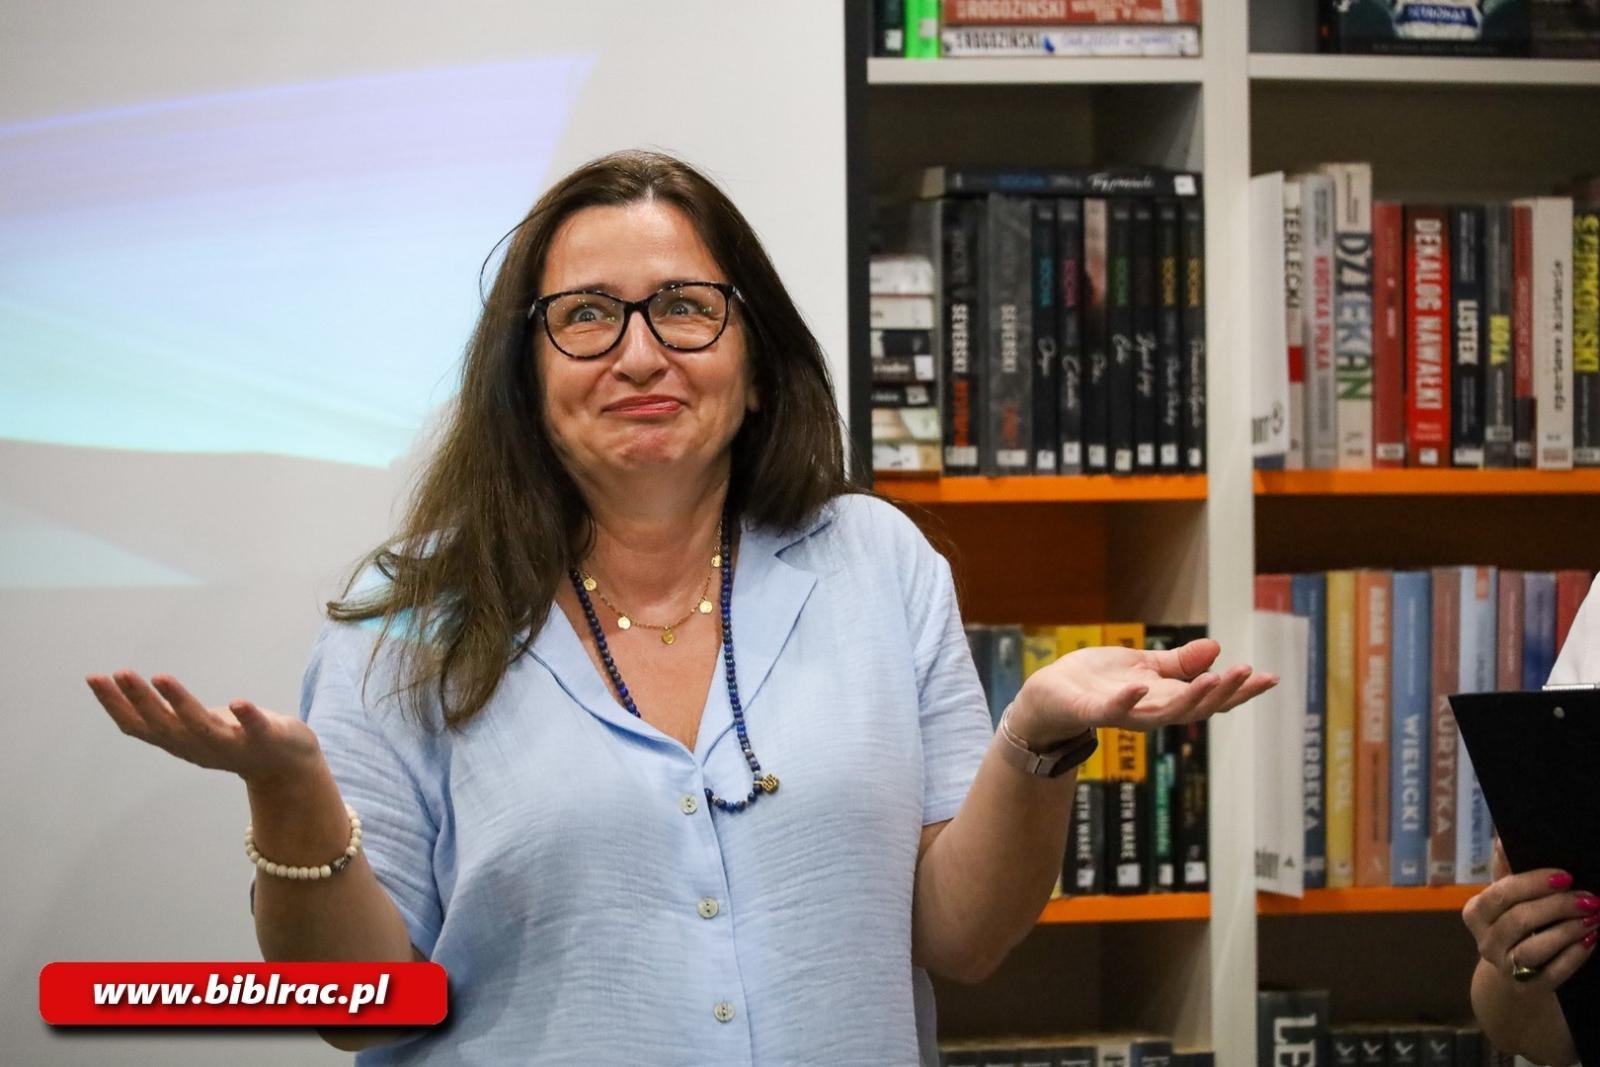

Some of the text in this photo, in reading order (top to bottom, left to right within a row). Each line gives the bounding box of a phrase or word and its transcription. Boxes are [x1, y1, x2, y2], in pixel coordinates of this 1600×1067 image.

[1284, 207, 1301, 309] TERLECKI
[1415, 218, 1443, 311] DEKALOG
[952, 304, 968, 373] SEVERSKI
[1001, 304, 1016, 373] SEVERSKI
[1335, 232, 1372, 401] DZIEKAN
[1416, 316, 1443, 410] NAWAŁKI
[1304, 713, 1322, 832] BERBEKA
[1402, 713, 1420, 832] WIELICKI
[1437, 694, 1455, 834] KURTYKA
[1121, 782, 1136, 859] RUTH WARE
